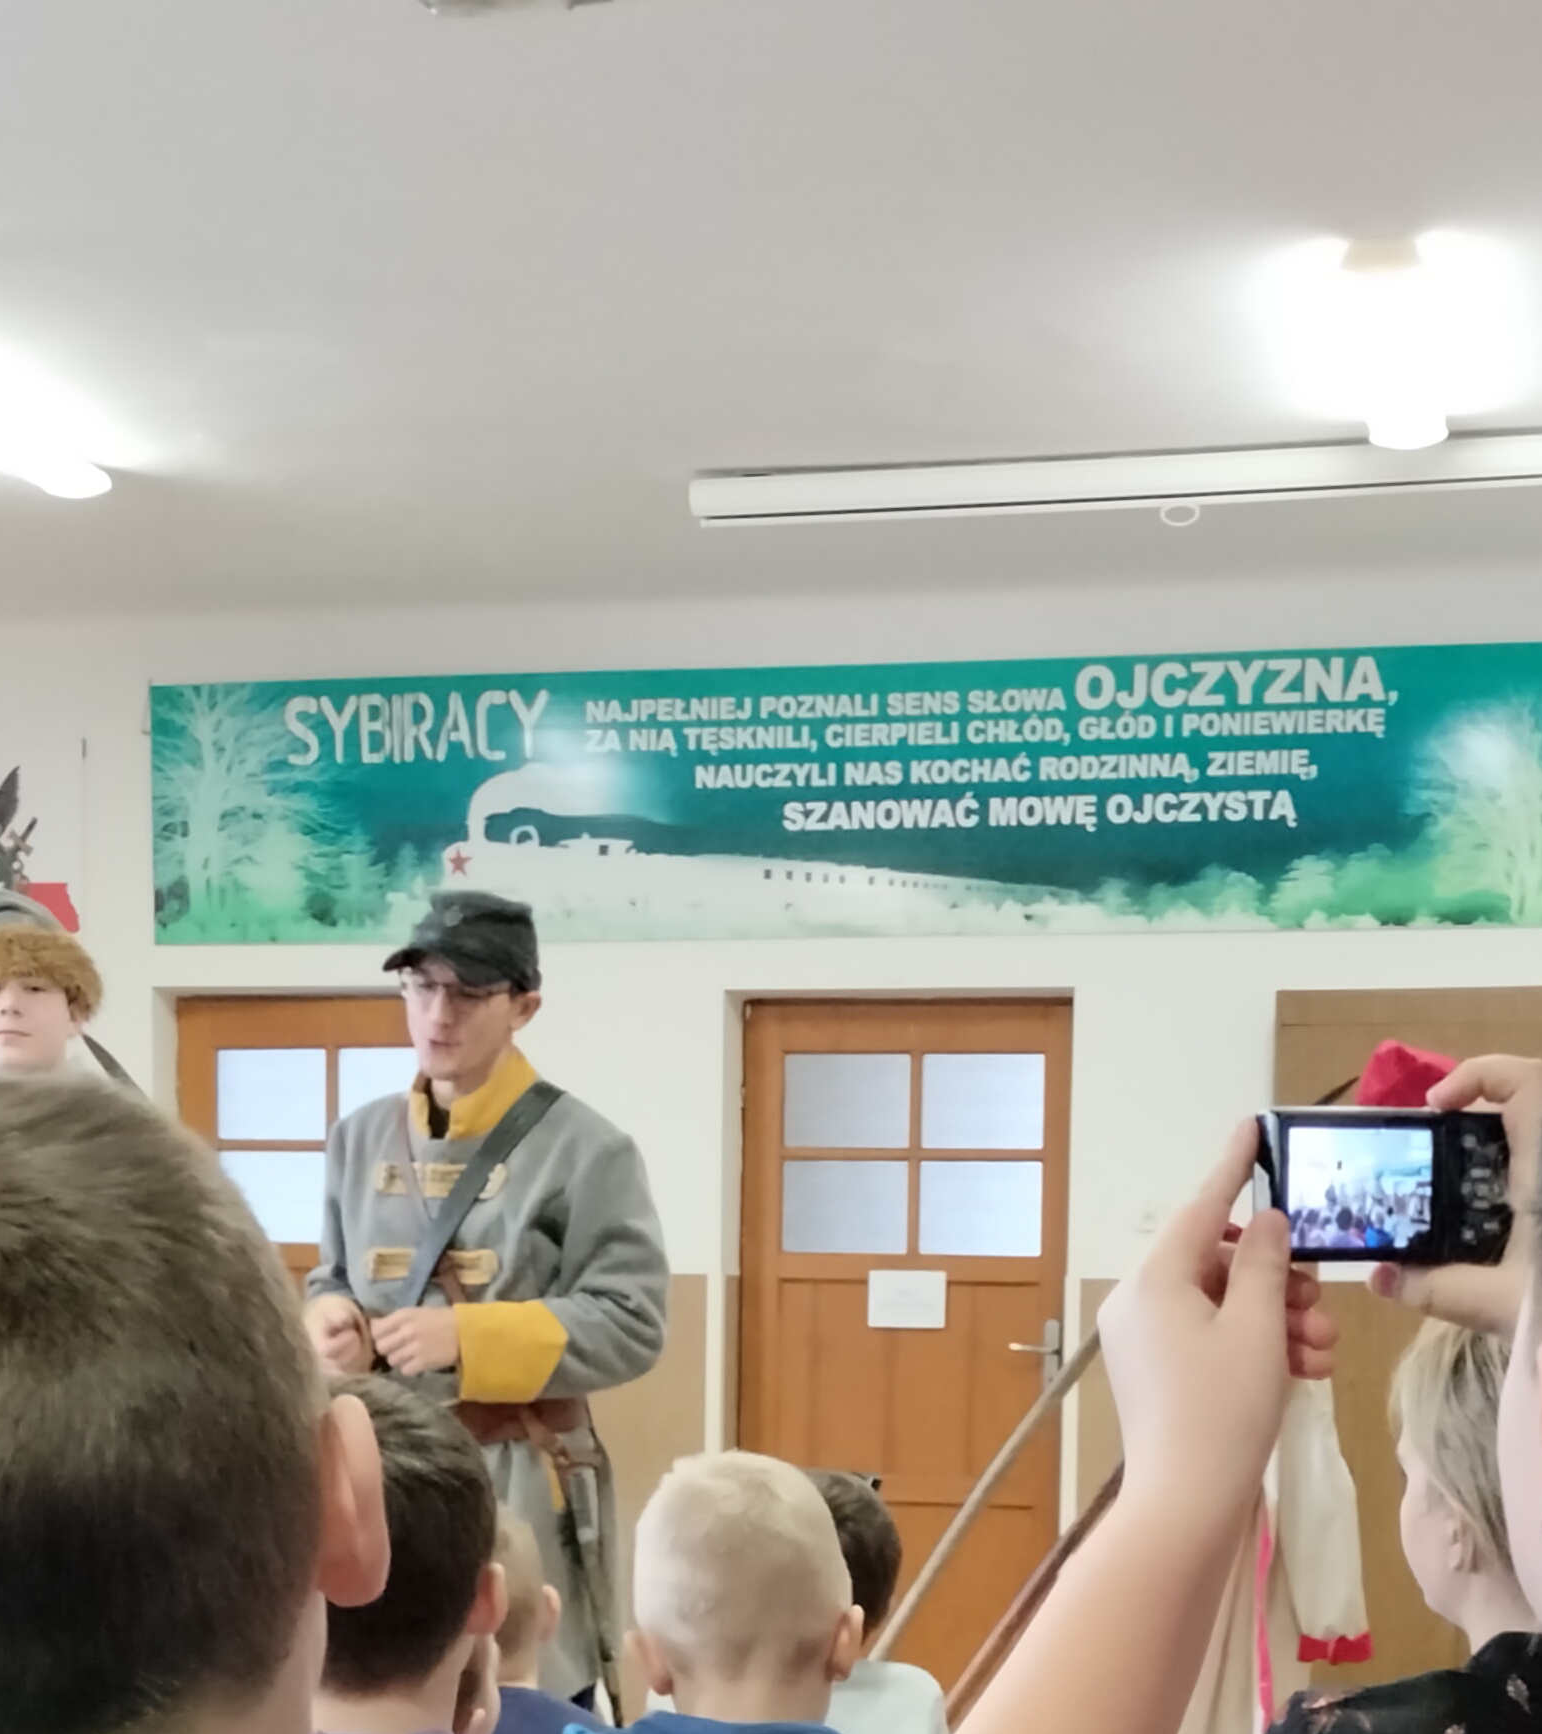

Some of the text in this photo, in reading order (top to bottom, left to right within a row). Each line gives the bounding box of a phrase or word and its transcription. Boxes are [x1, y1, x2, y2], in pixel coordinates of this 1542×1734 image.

[586, 655, 1399, 723] NAJPEŁNIEJ POZNALI SENS SŁOWA OJCZYZNA,
[284, 689, 550, 766] SYBIRACY
[585, 708, 1386, 757] ZA NIĄ TĘSKNILI, CIERPIELI CHŁÓD, GŁÓD I PONIEWIERKĘ
[695, 763, 837, 789] NAUCZYLI
[844, 761, 903, 786] NAS
[910, 752, 1031, 784] KOCHAĆ
[782, 790, 1298, 832] SZANOWAĆ MOWĘ OJCZYSTĄ
